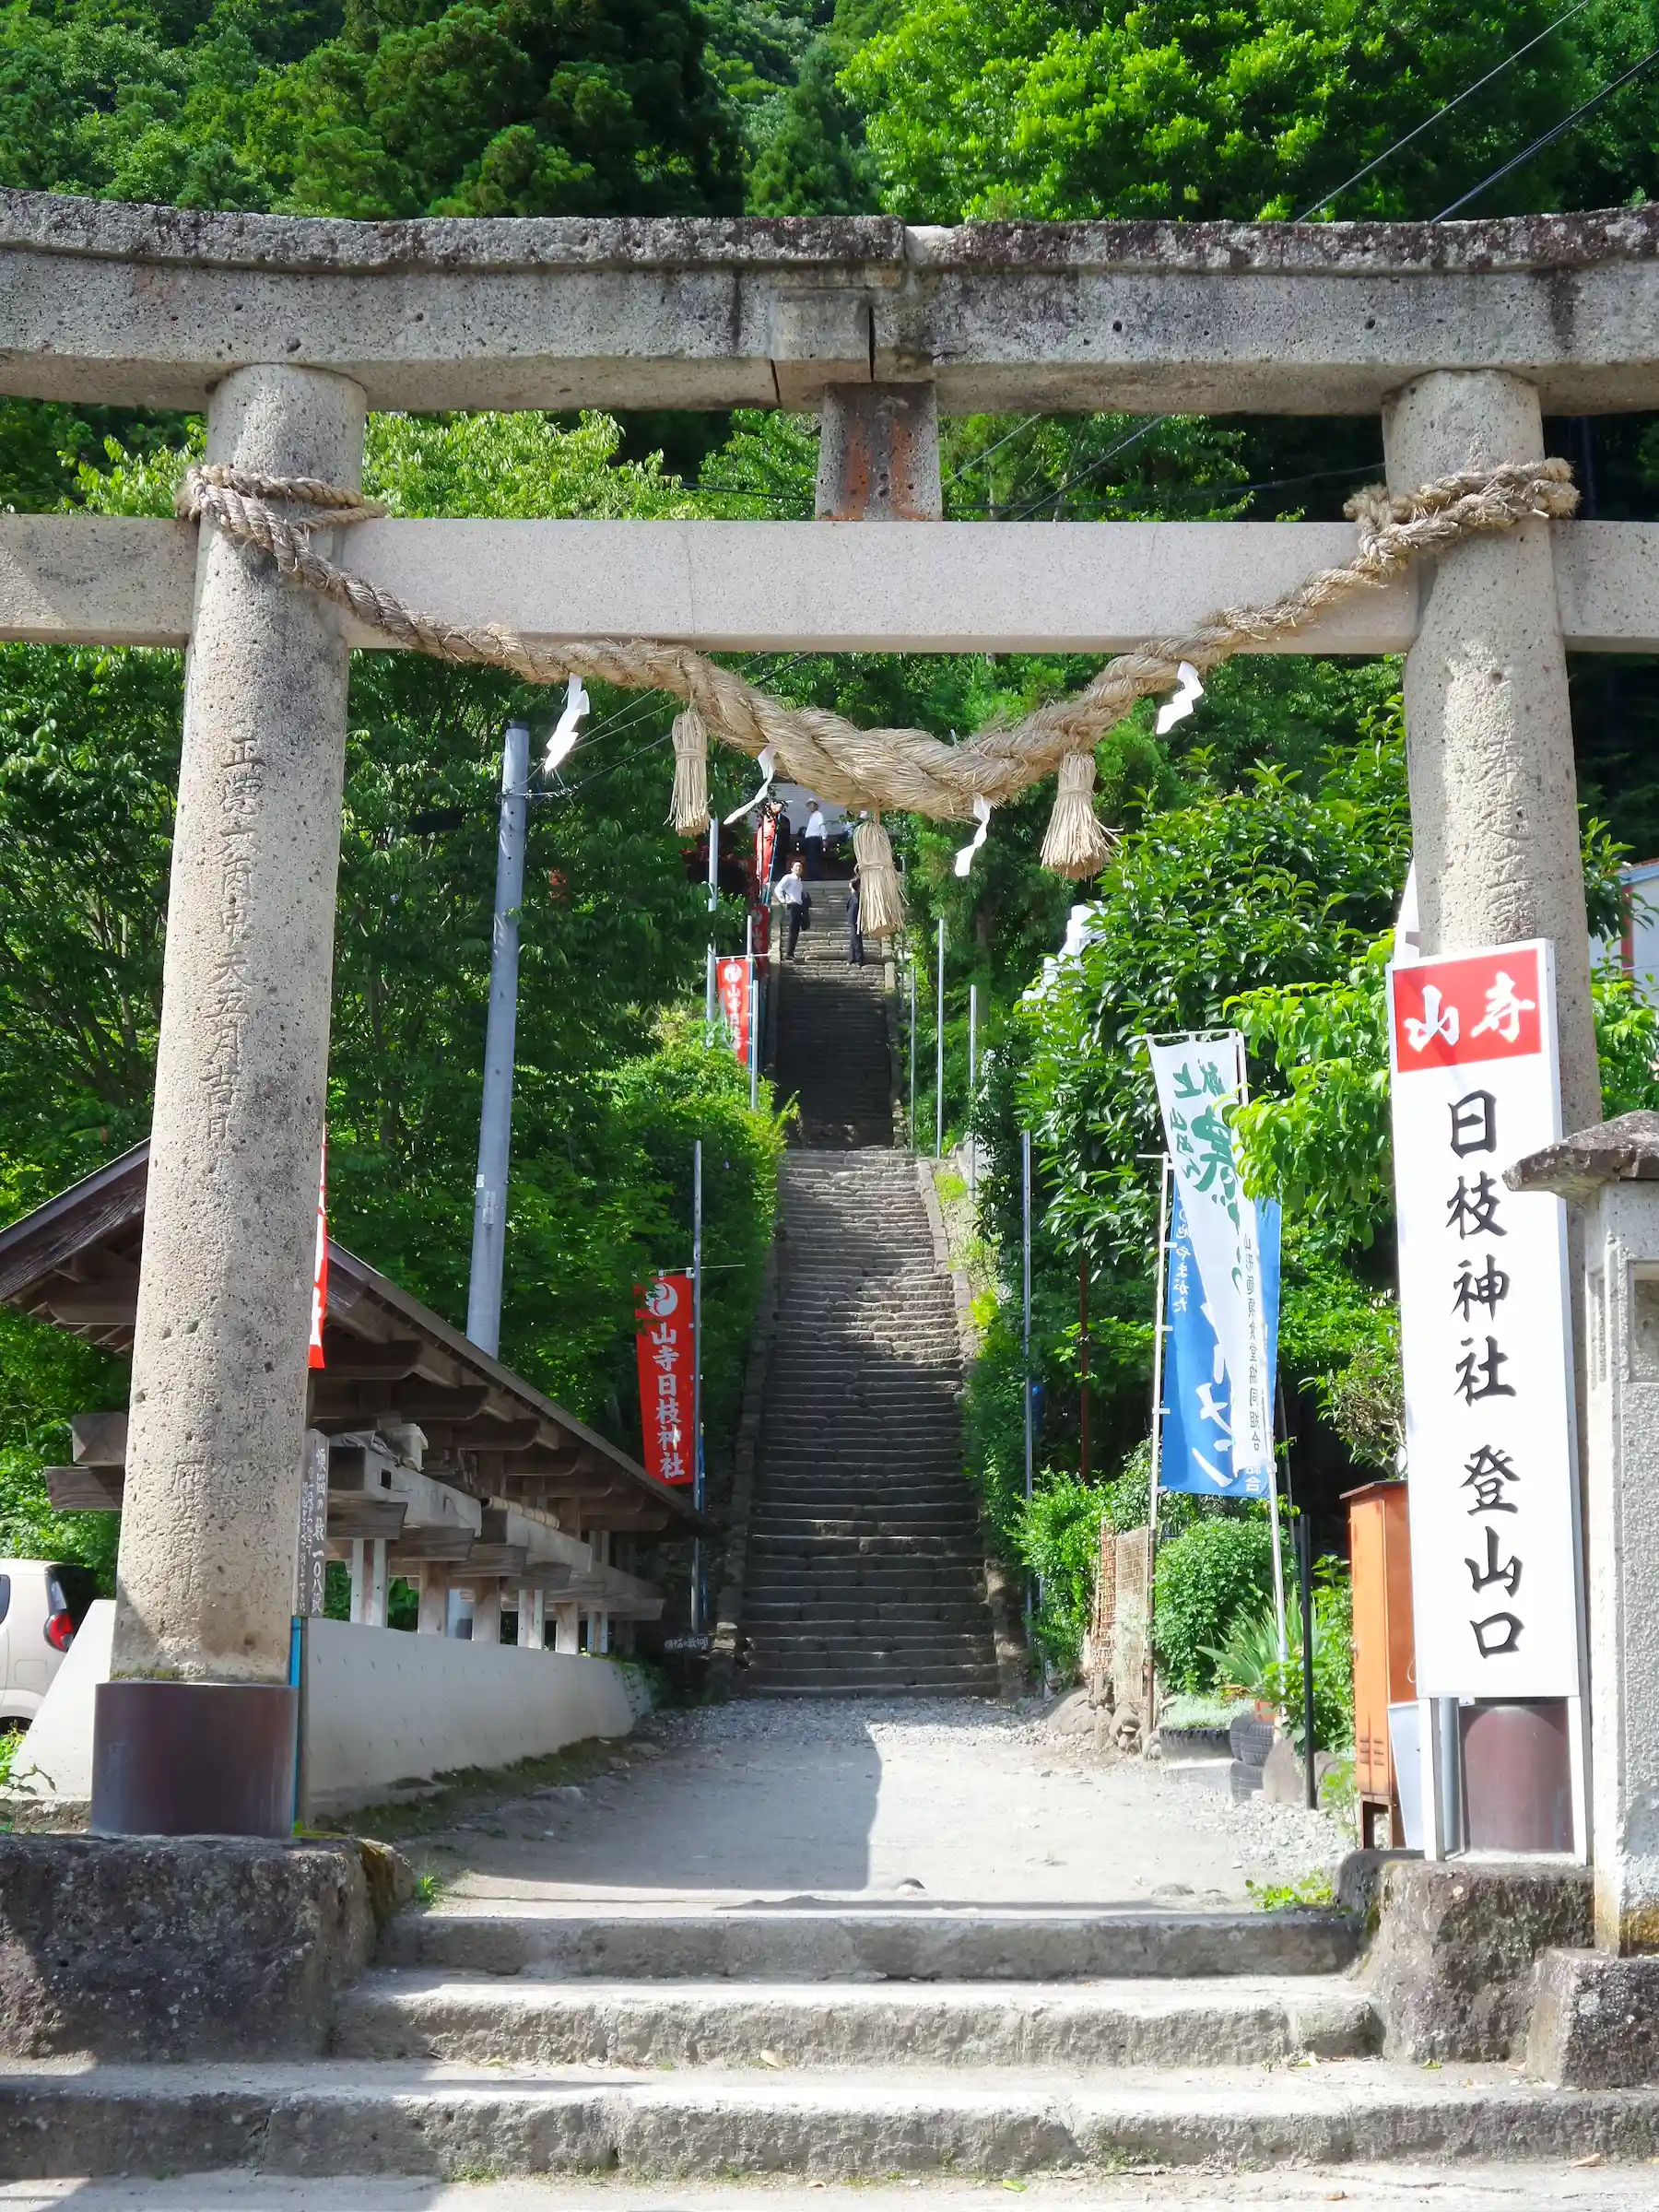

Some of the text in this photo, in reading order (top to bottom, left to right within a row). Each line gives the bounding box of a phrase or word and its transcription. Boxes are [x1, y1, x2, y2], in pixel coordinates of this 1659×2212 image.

[1403, 971, 1536, 1053] 山寺
[650, 1321, 686, 1479] 山寺日枝神社
[1445, 1088, 1525, 1660] 日枝神社 登山口
